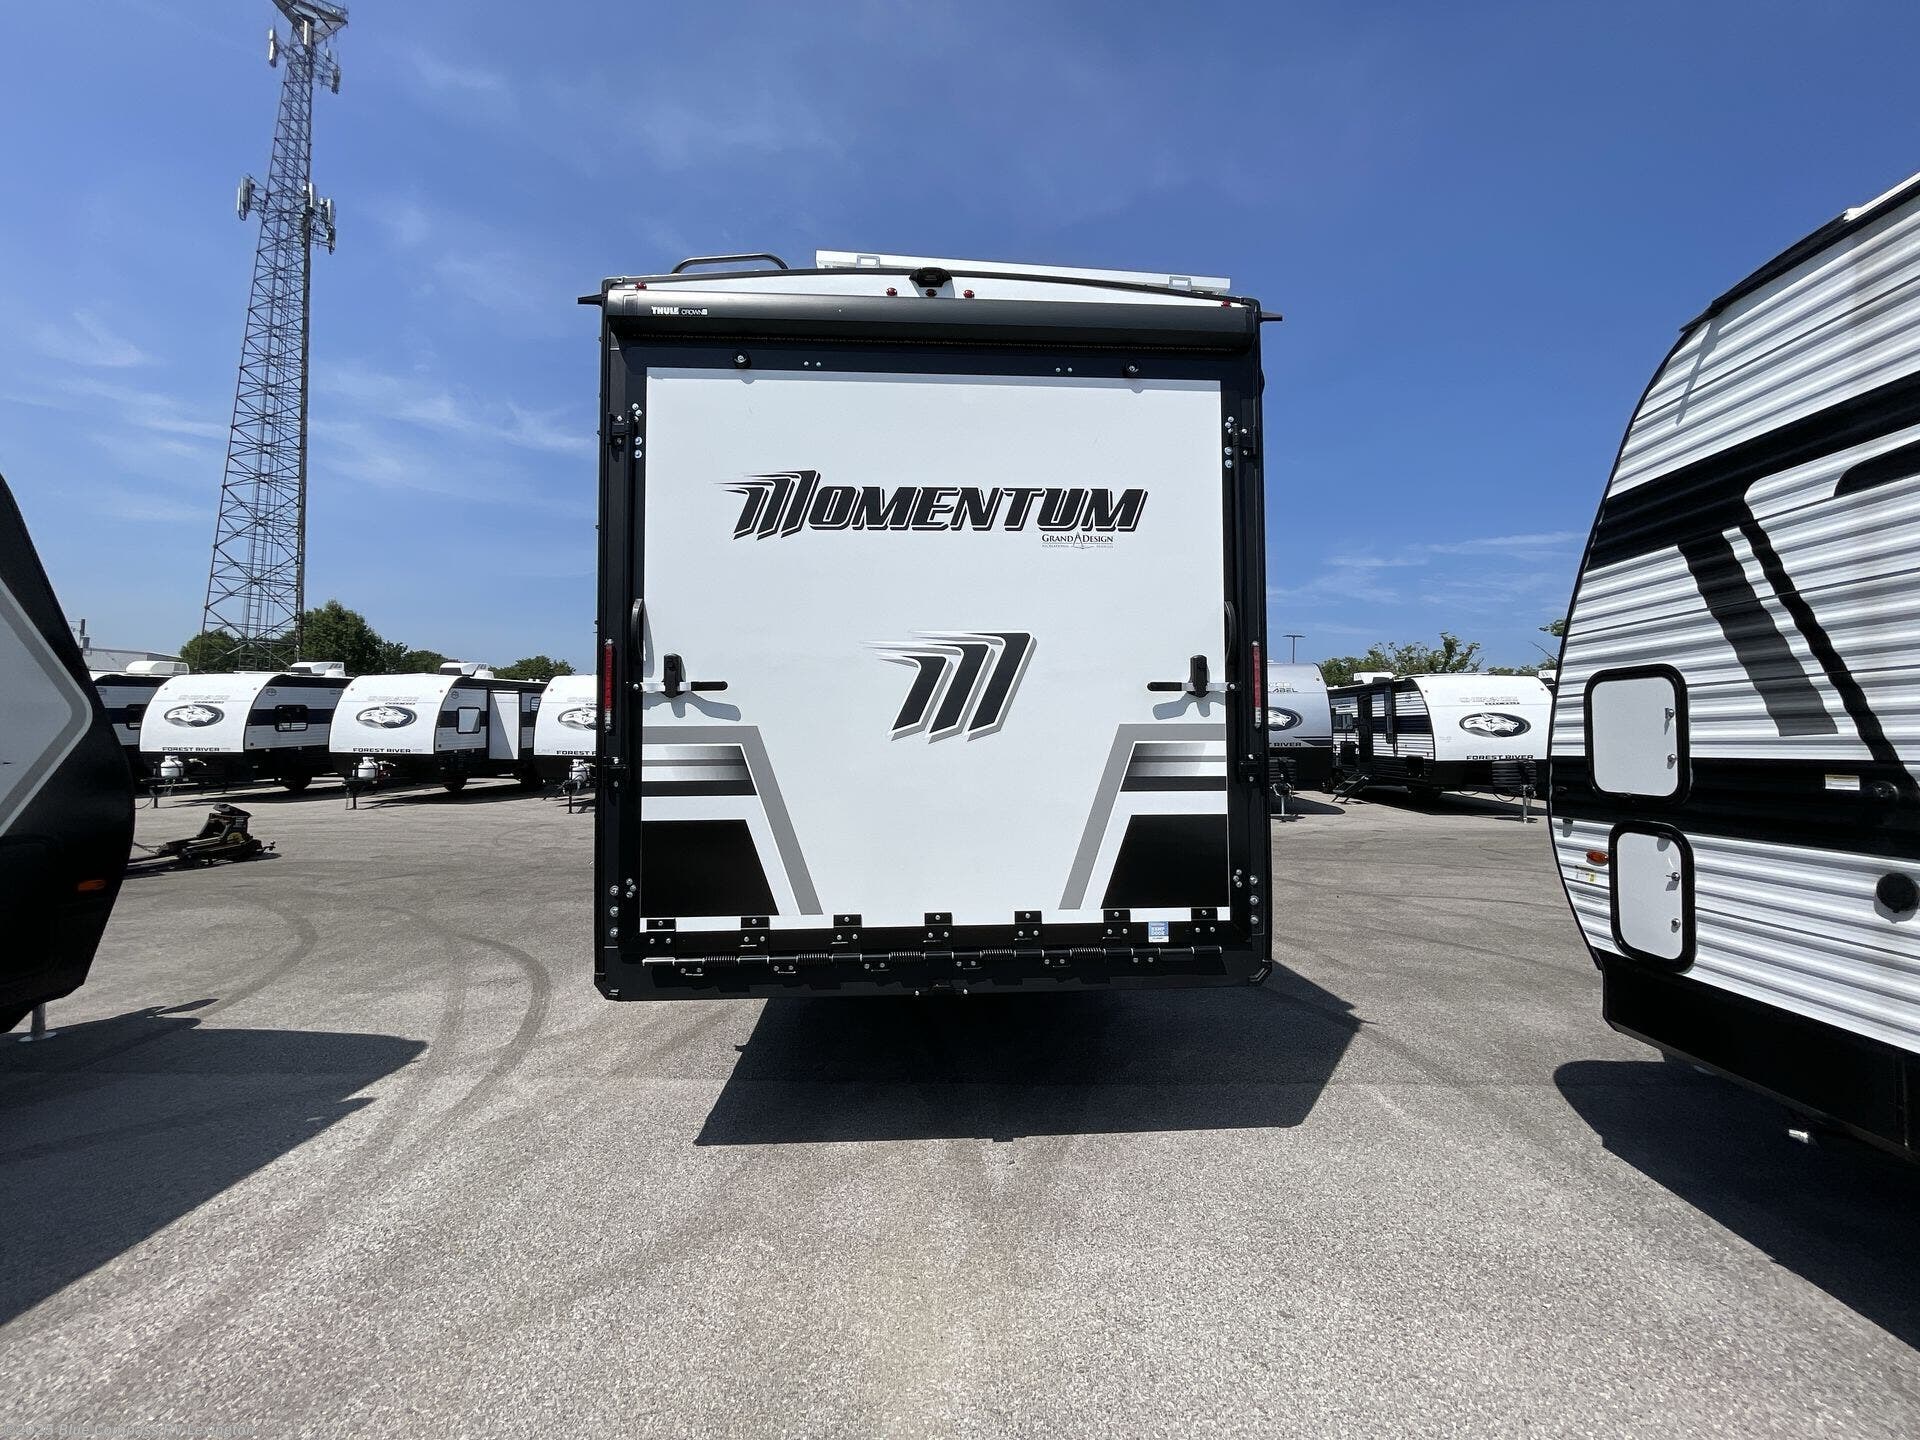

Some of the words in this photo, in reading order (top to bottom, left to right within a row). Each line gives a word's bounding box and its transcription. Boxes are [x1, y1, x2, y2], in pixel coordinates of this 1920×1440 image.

[651, 306, 679, 315] THULE
[716, 469, 1148, 540] MOMENTUM
[1041, 533, 1074, 543] GRAND
[1082, 533, 1114, 543] DESIGN
